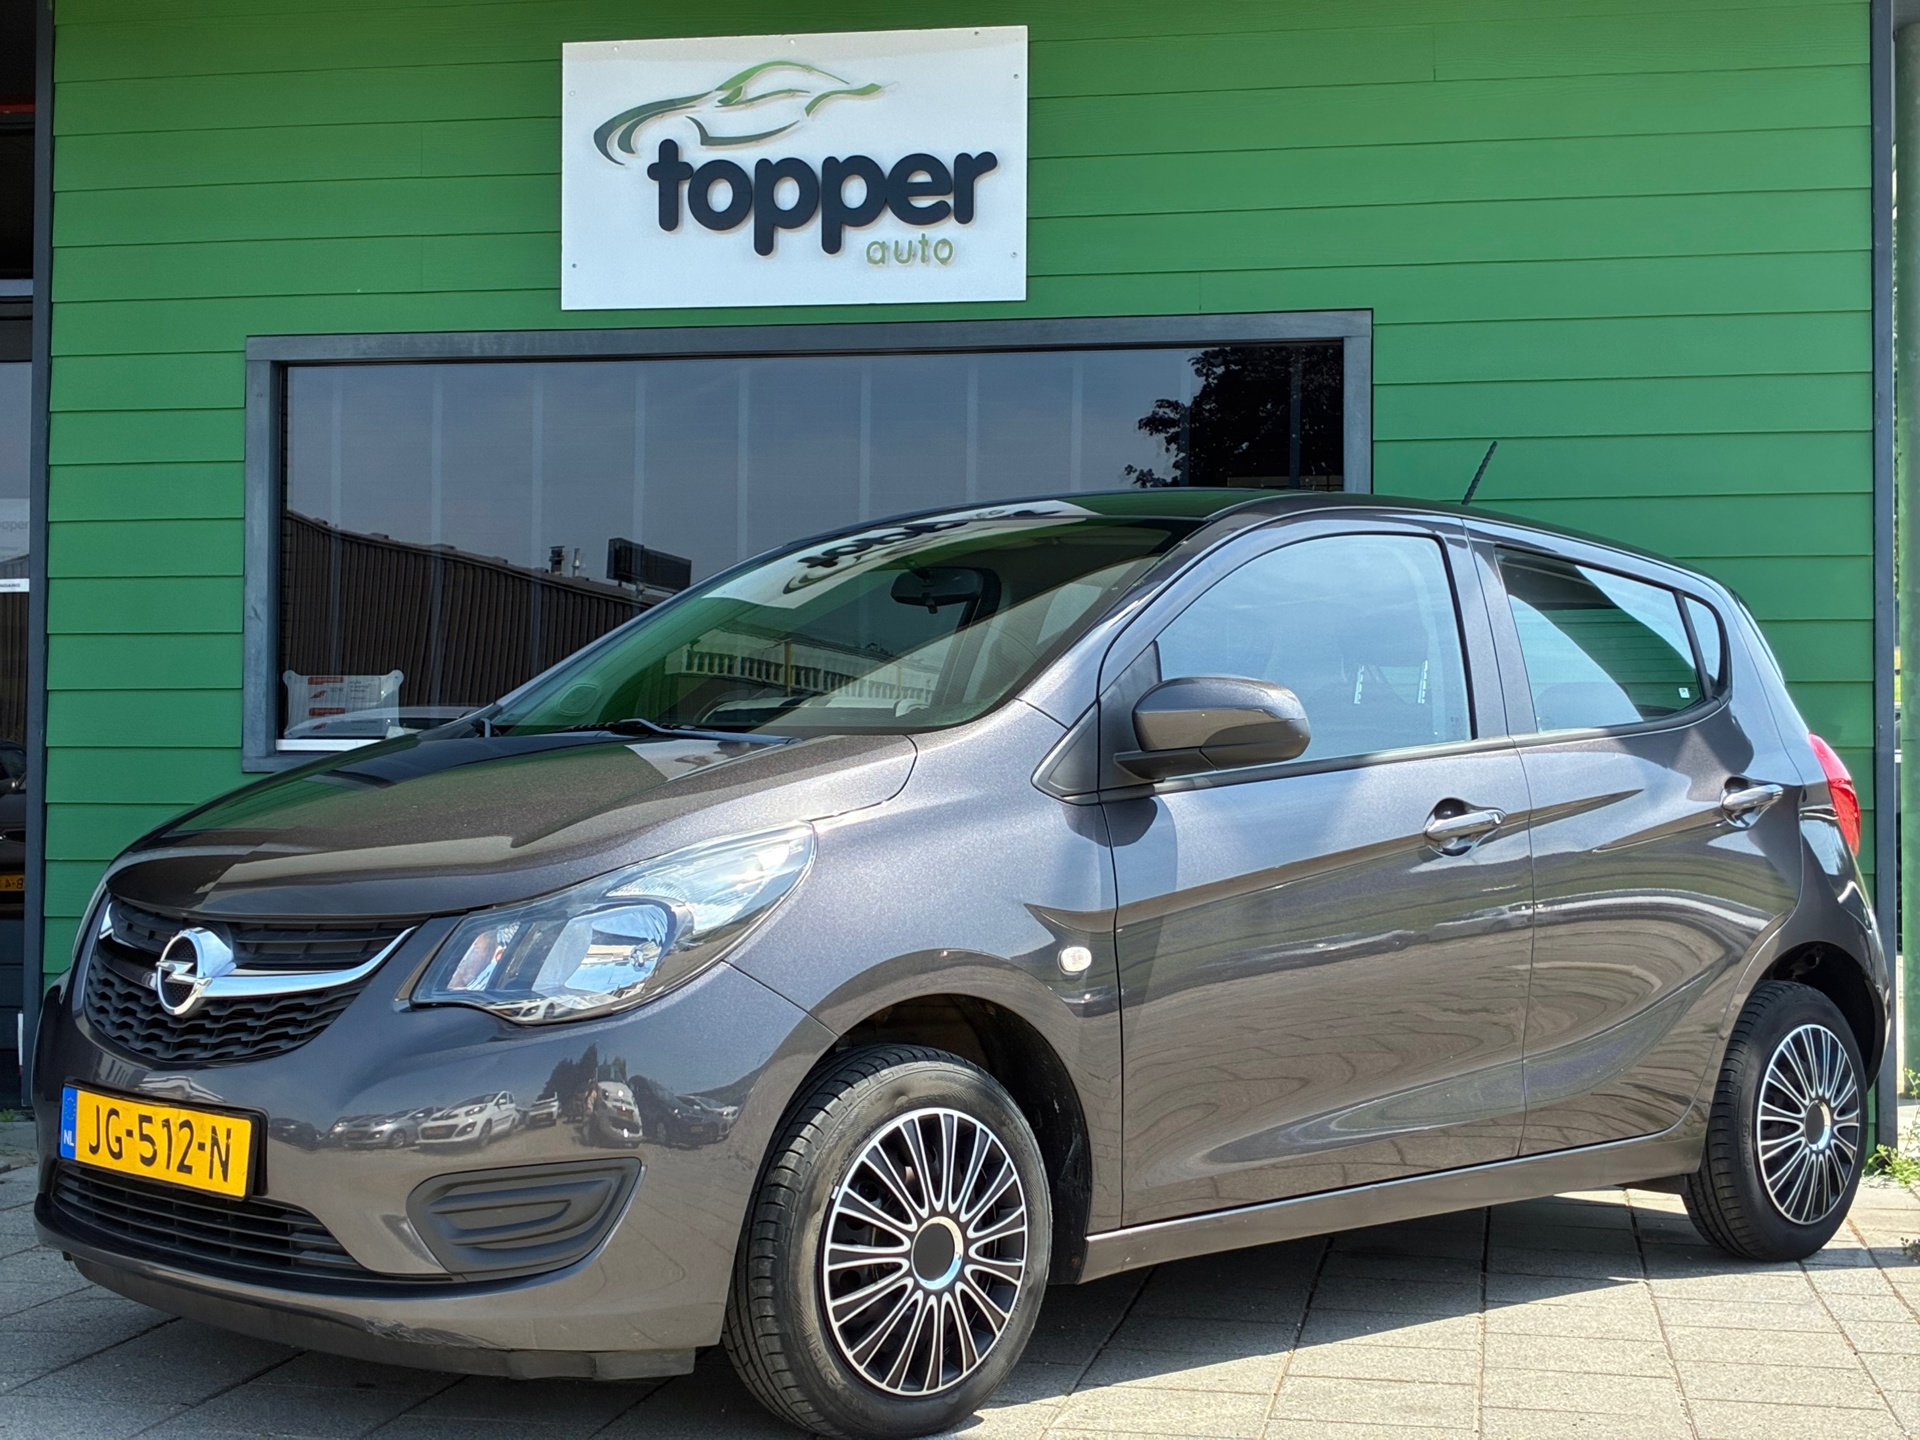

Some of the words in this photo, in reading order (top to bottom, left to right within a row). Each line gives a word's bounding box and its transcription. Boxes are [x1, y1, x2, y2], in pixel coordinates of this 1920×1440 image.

[646, 138, 998, 256] topper
[866, 233, 954, 265] auto
[63, 1128, 75, 1147] NL
[88, 1104, 232, 1183] JG-512-N
